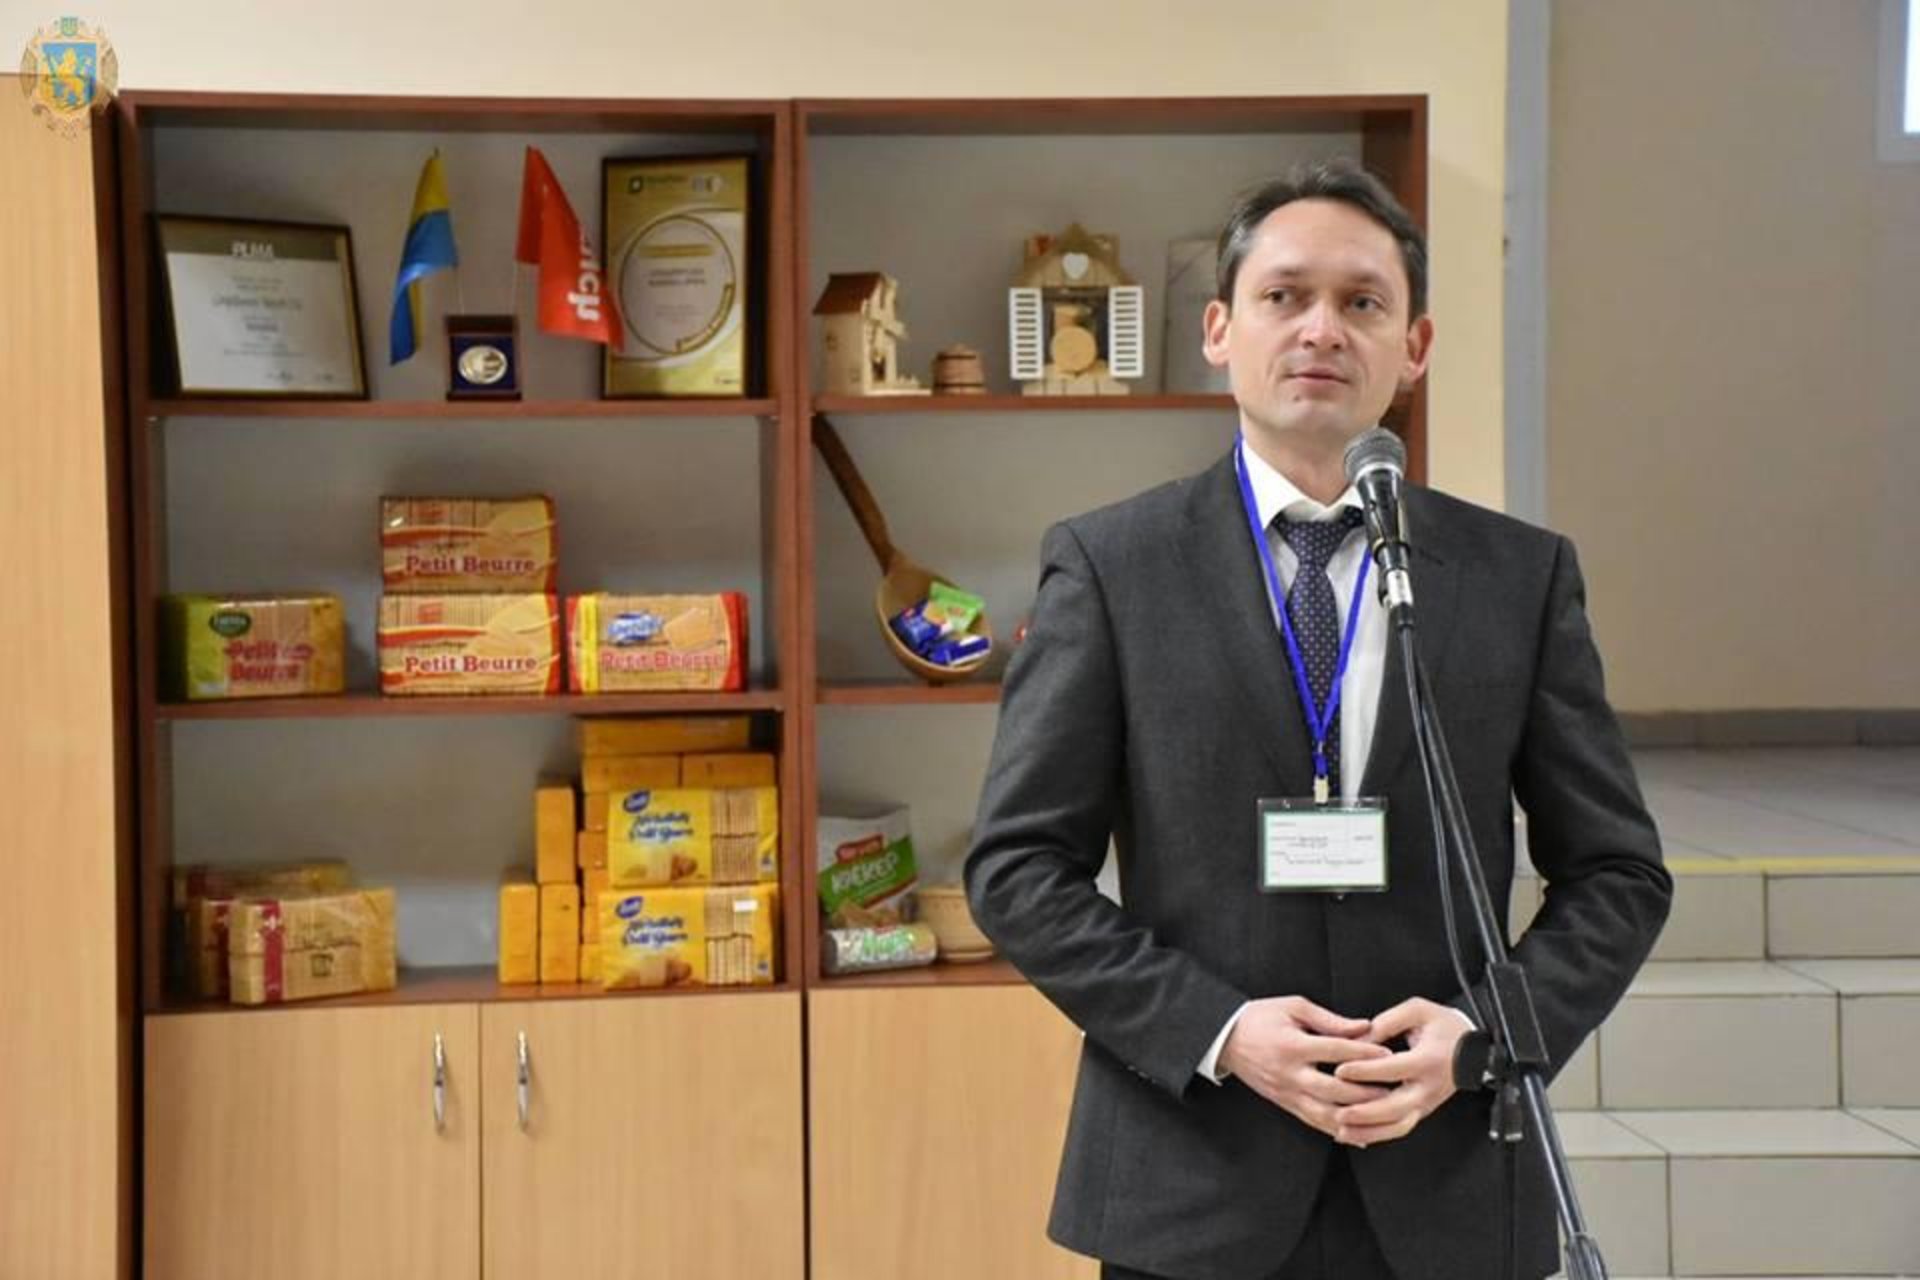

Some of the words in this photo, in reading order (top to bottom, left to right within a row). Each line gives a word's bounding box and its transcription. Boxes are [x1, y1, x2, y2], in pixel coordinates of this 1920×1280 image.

[404, 554, 456, 572] Petit
[462, 555, 536, 572] Beurre
[404, 655, 456, 673] Petit
[462, 655, 538, 673] Beurre
